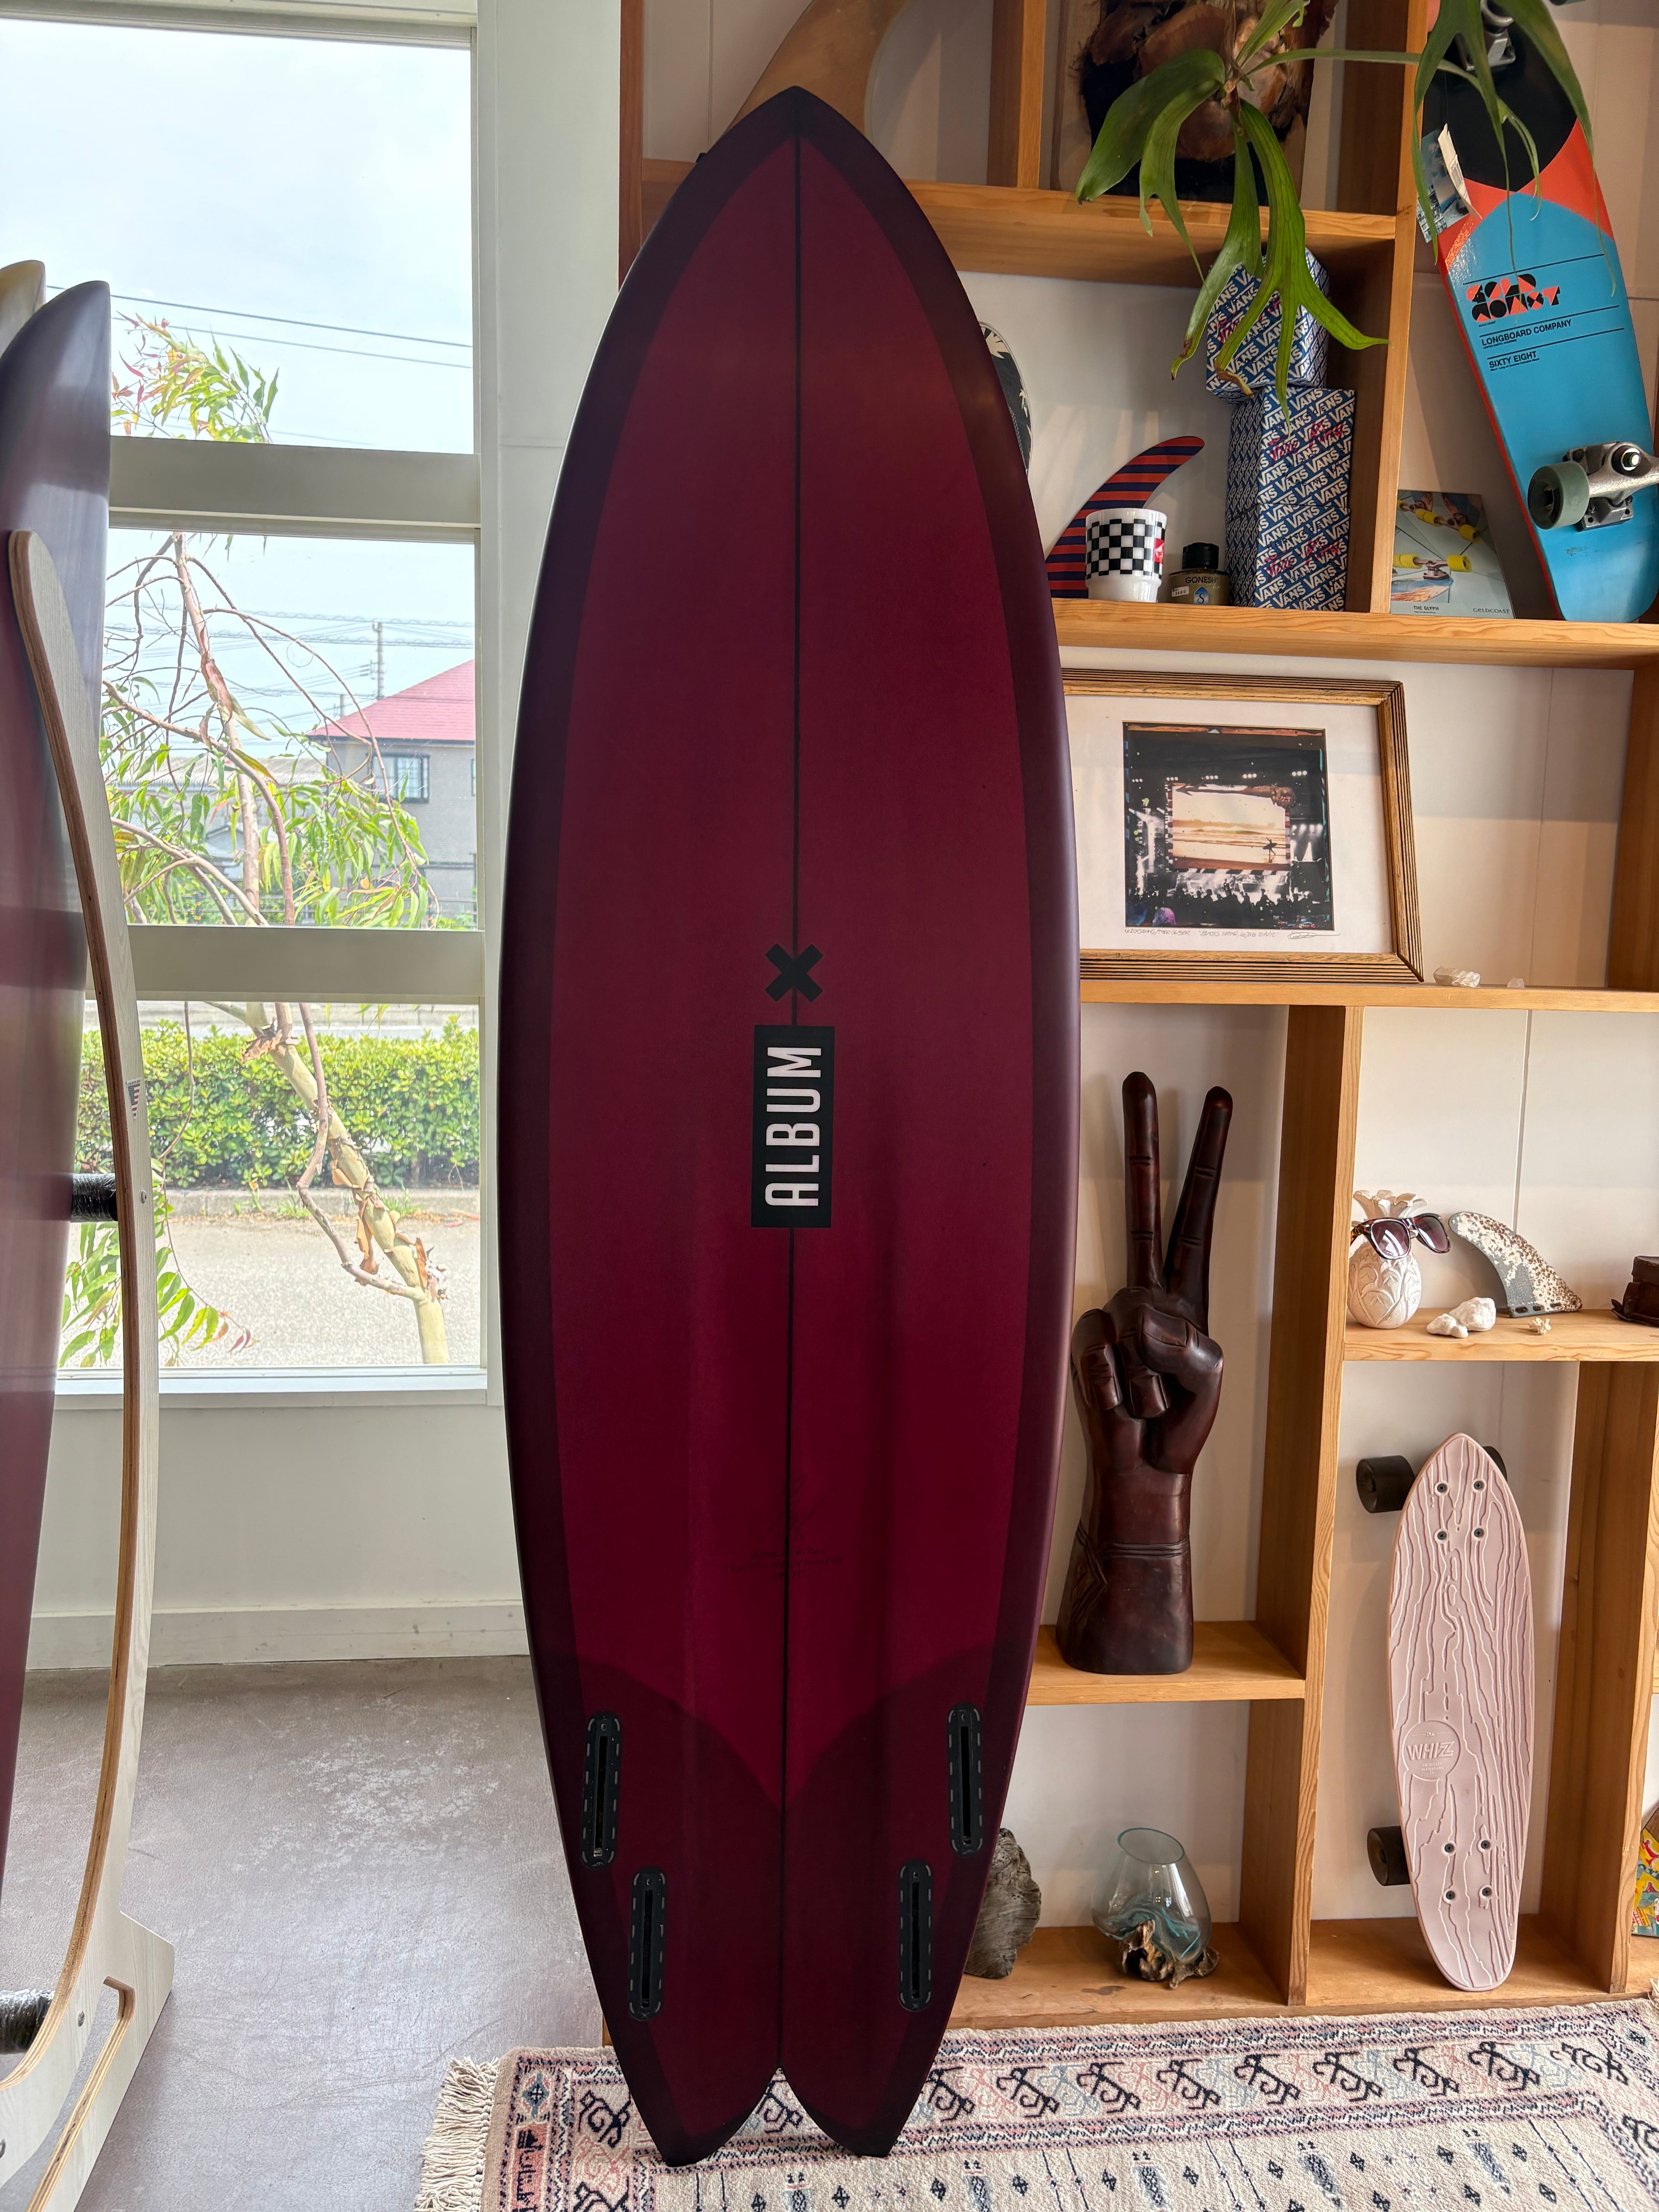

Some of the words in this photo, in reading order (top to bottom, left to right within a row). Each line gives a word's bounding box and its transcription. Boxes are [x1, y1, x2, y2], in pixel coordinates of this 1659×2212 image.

[1482, 328, 1532, 346] LONGBOARD
[1534, 319, 1571, 333] COMPANY
[1489, 356, 1511, 368] SIXTY
[1513, 351, 1536, 362] EIGHT
[1289, 388, 1323, 411] VANS
[1309, 389, 1343, 417] VANS
[1281, 409, 1312, 435] VANS
[1297, 415, 1331, 442] VANS
[1317, 421, 1350, 448] VANS
[1266, 434, 1300, 461] VANS
[1286, 440, 1319, 467] VANS
[1306, 447, 1339, 473] VANS
[1258, 460, 1288, 486] VANS
[1275, 465, 1308, 492] VANS
[1295, 471, 1328, 498] VANS
[1314, 477, 1348, 504] VANS
[1286, 505, 1320, 528] VANS
[1306, 508, 1339, 534] VANS
[1257, 521, 1288, 547] VANS
[1278, 527, 1308, 553] VANS
[1295, 532, 1328, 559] VANS
[1264, 551, 1297, 577] VANS
[1314, 538, 1347, 564] VANS
[1284, 557, 1317, 583] VANS
[1303, 564, 1336, 589] VANS
[1254, 576, 1286, 602] VANS
[1273, 582, 1305, 608] VANS
[1292, 587, 1325, 610] VANS
[764, 1047, 821, 1207] ALBUM
